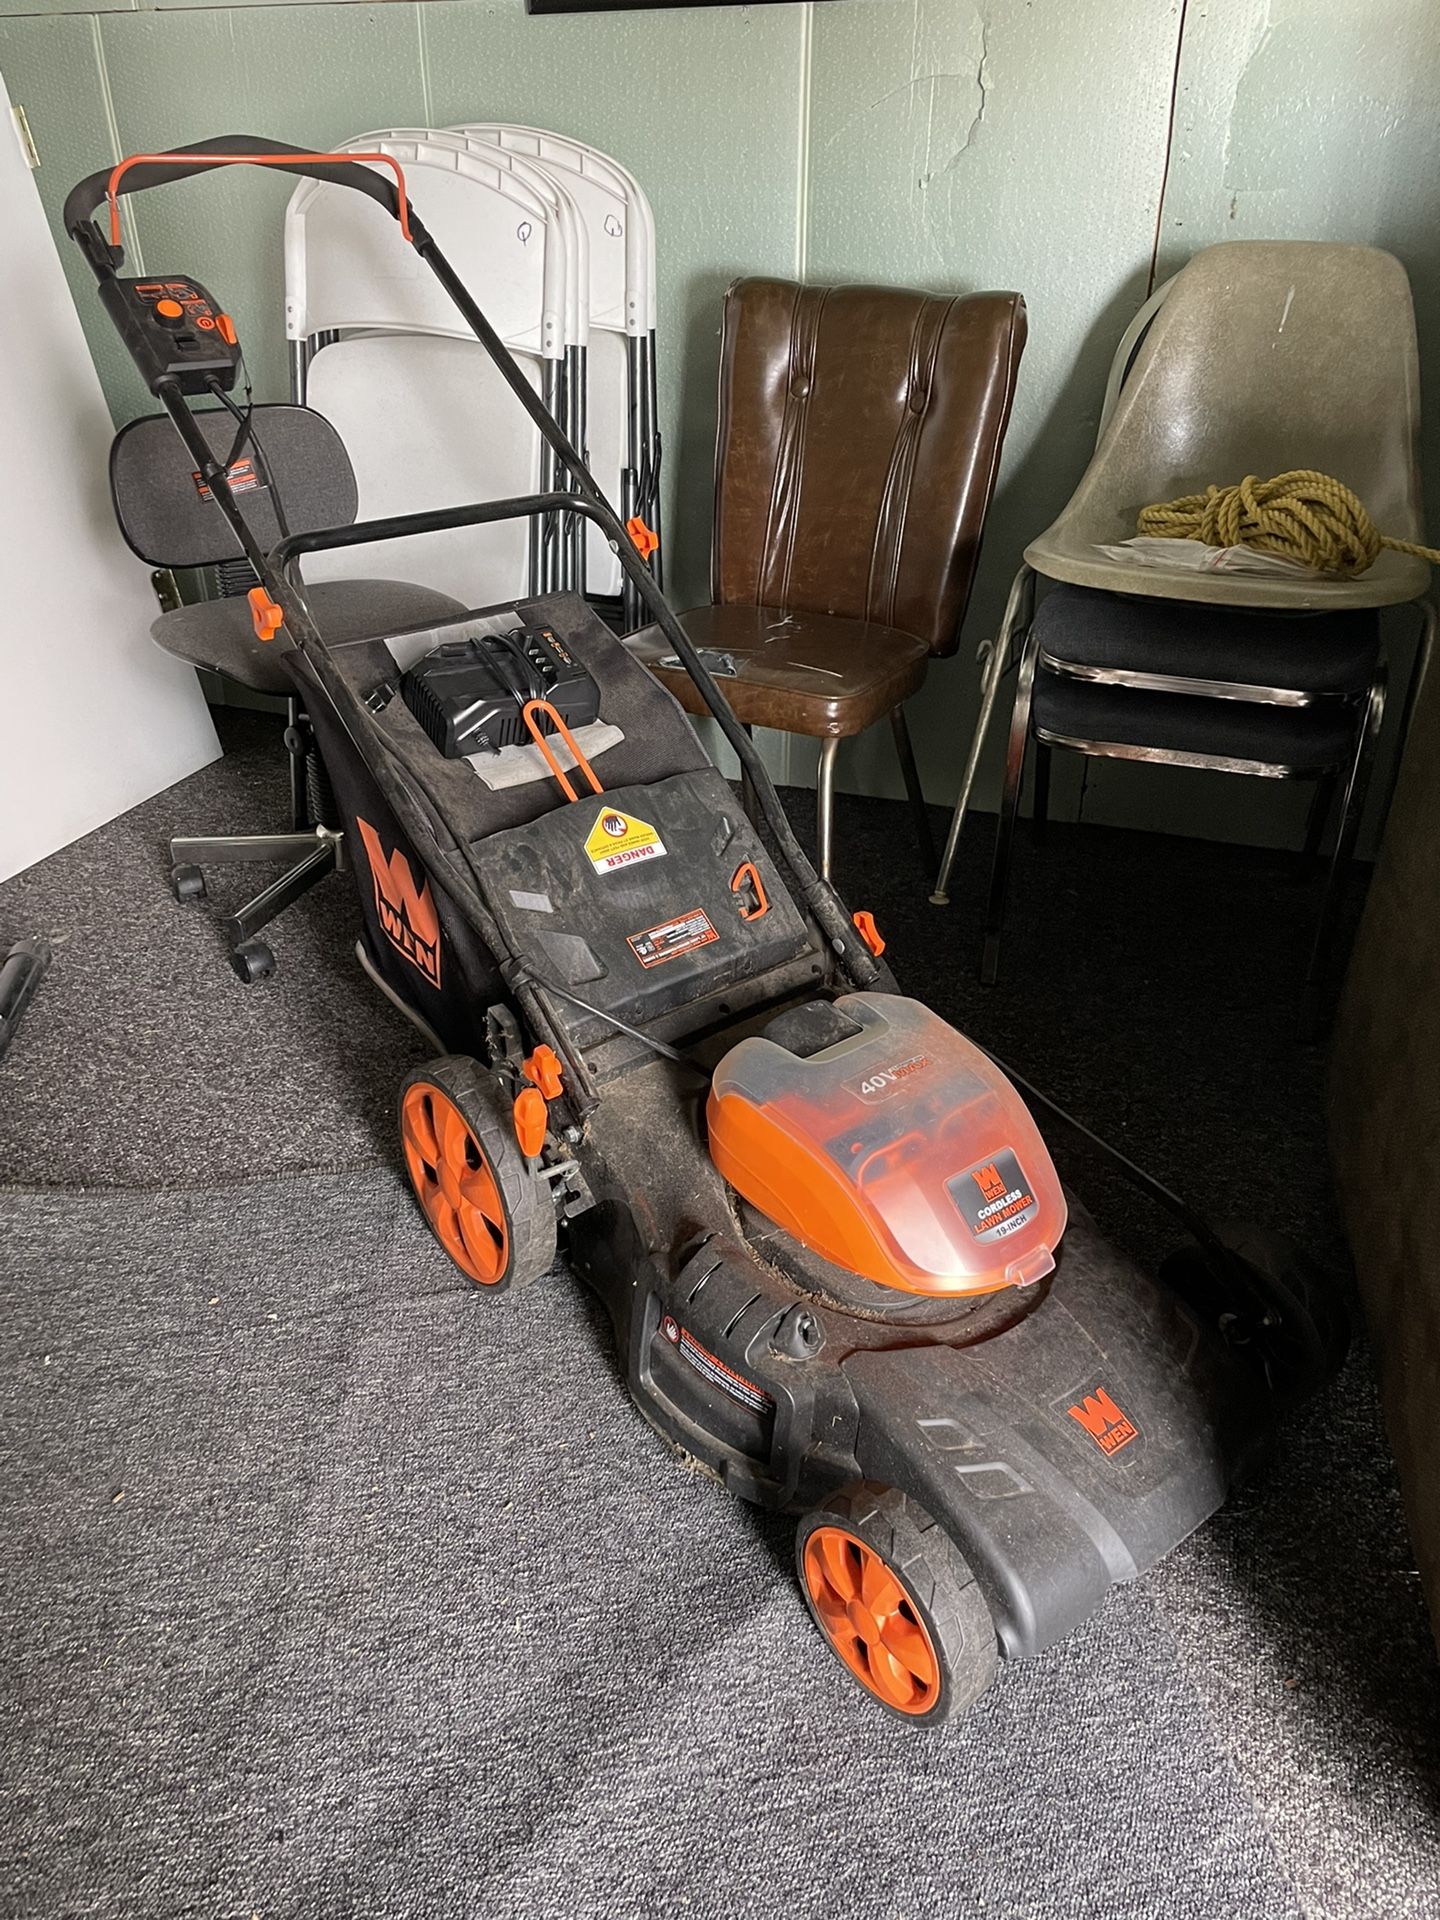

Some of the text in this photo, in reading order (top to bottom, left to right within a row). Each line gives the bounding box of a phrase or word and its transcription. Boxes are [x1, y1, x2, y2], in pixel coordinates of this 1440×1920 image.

[606, 845, 655, 867] DANGER
[861, 1068, 897, 1094] 40V
[977, 1189, 1022, 1219] CORDLESS
[985, 1185, 1005, 1199] WEN
[974, 1195, 1033, 1233] LAWN MOWER
[996, 1214, 1027, 1236] 19-INCH
[1099, 1421, 1134, 1449] WEN
